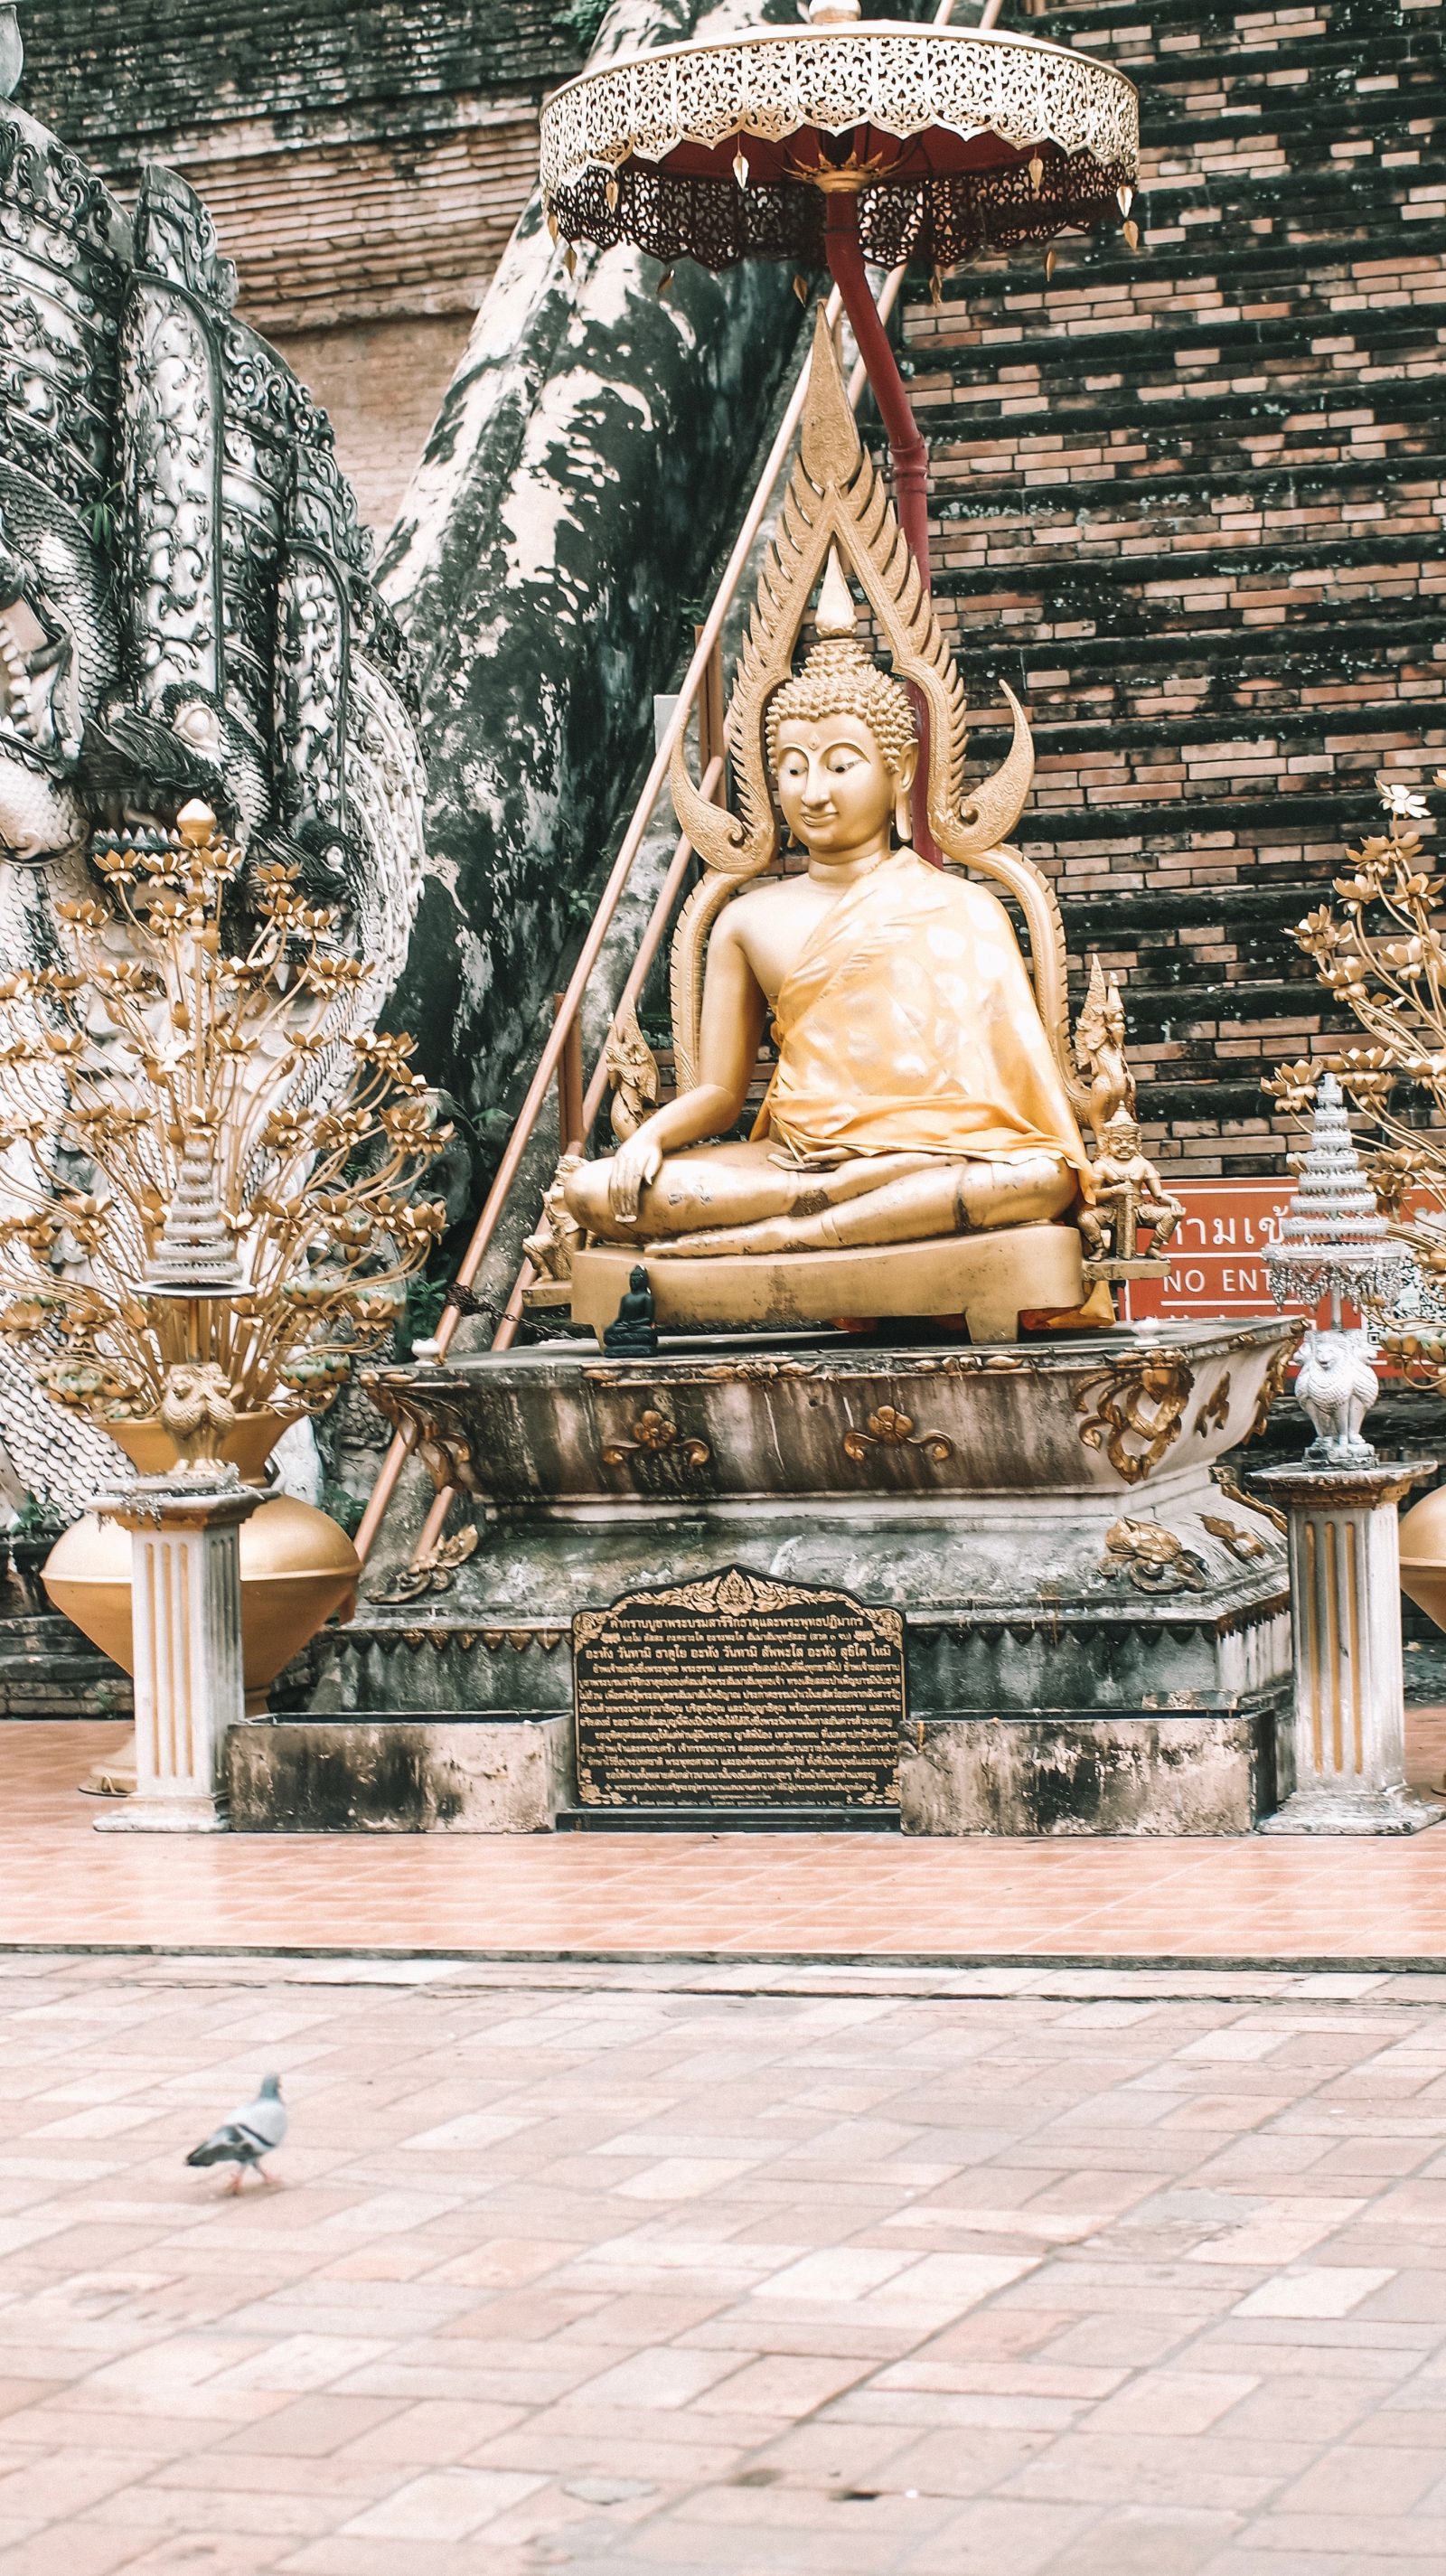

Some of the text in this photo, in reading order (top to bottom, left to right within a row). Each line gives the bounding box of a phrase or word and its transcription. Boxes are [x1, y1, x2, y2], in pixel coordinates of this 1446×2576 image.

[1163, 1205, 1310, 1245] ามเข้
[1163, 1269, 1272, 1293] NO ENT
[616, 1645, 652, 1659] วันทามิ
[722, 1644, 757, 1659] วันทามิ
